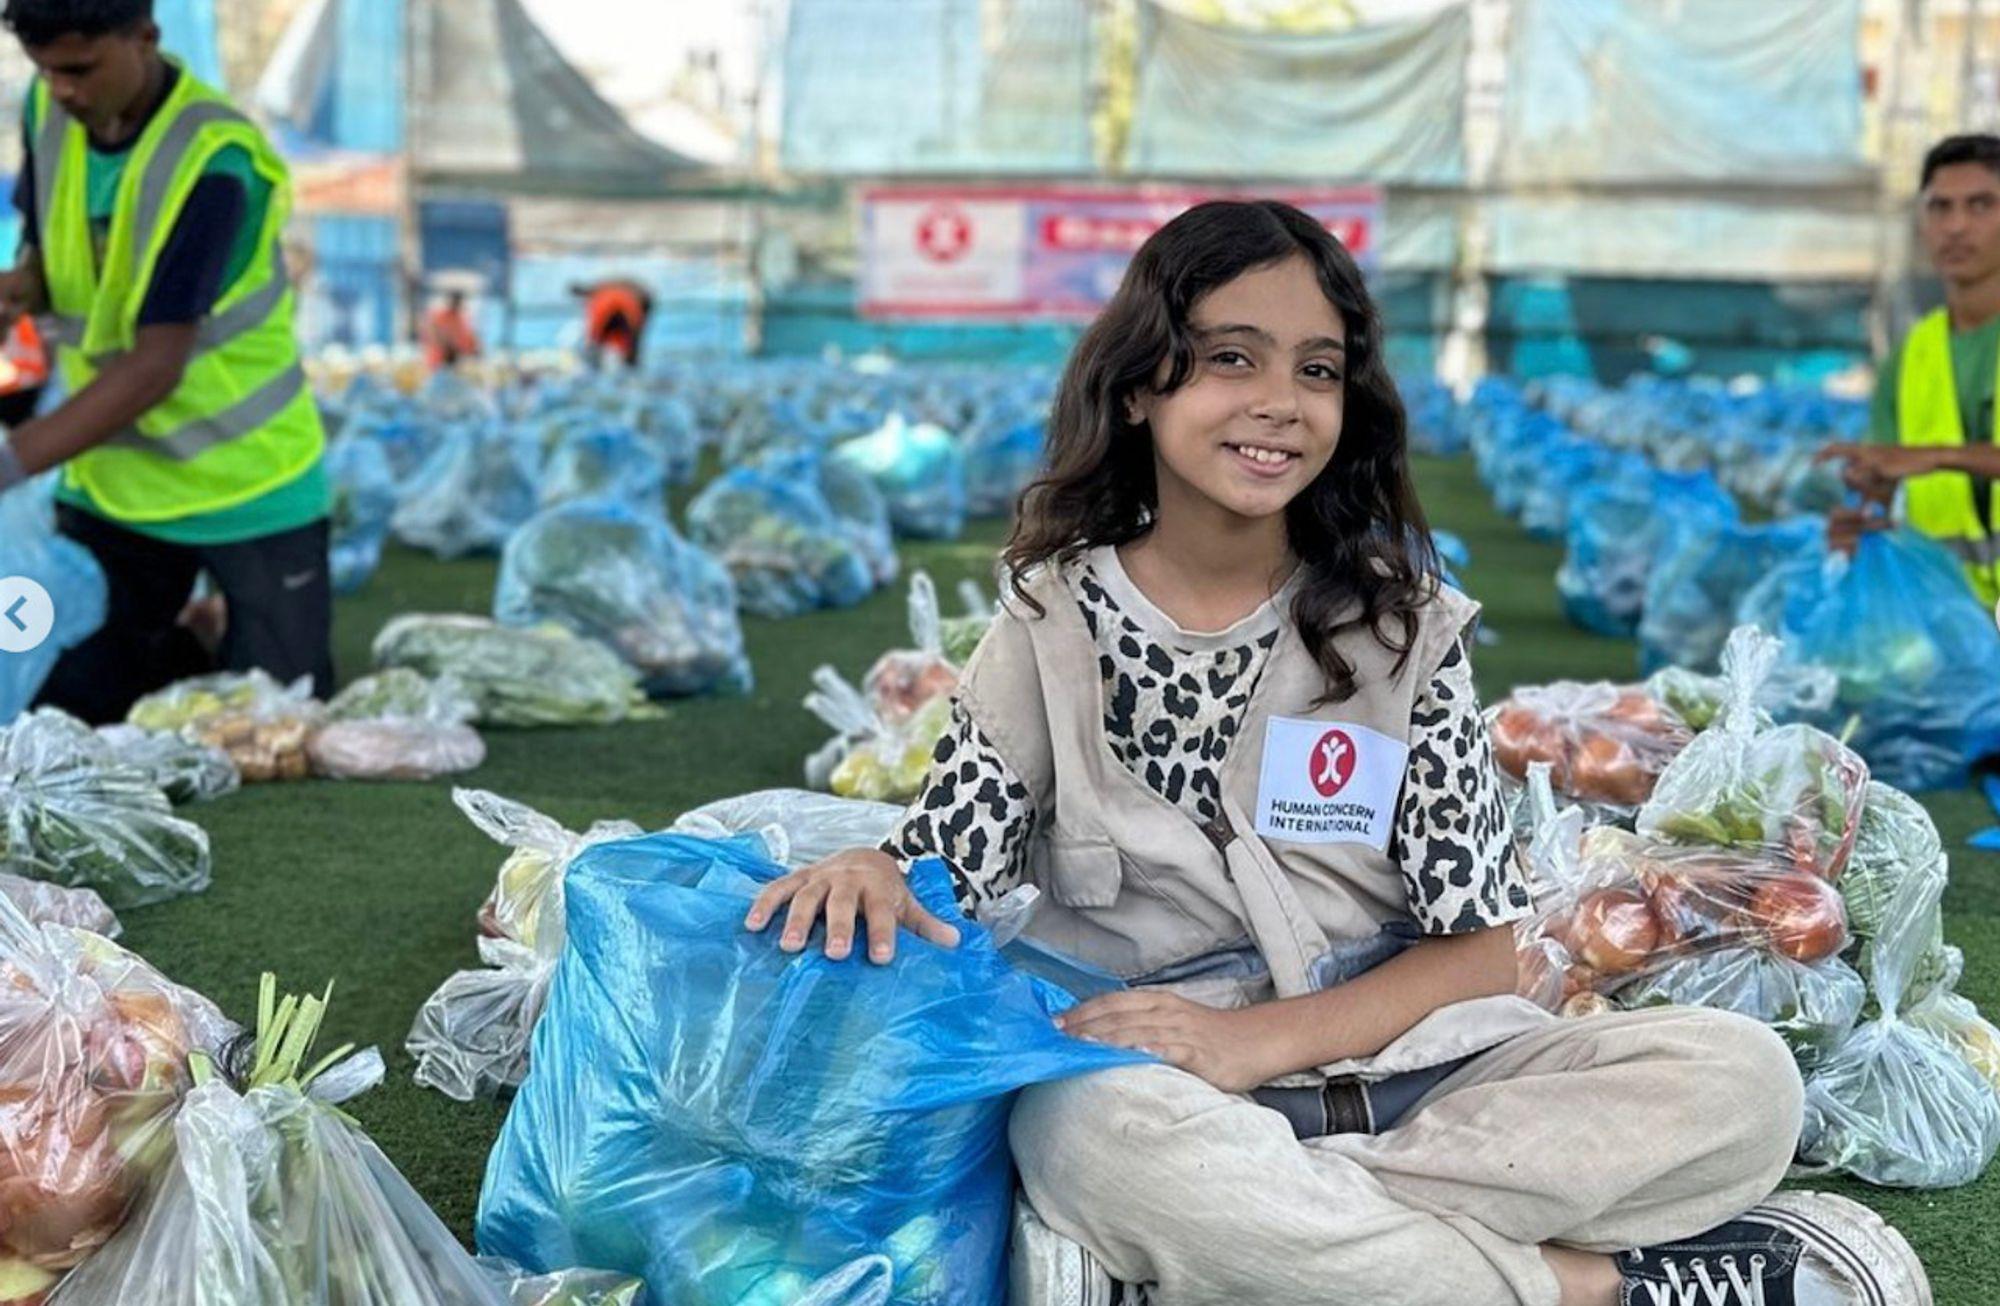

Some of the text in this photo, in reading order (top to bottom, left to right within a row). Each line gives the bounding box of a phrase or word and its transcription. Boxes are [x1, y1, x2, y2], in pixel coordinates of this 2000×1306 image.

[1271, 798, 1375, 820] HUMAN CONCERN
[1269, 815, 1370, 835] INTERNATIONAL
